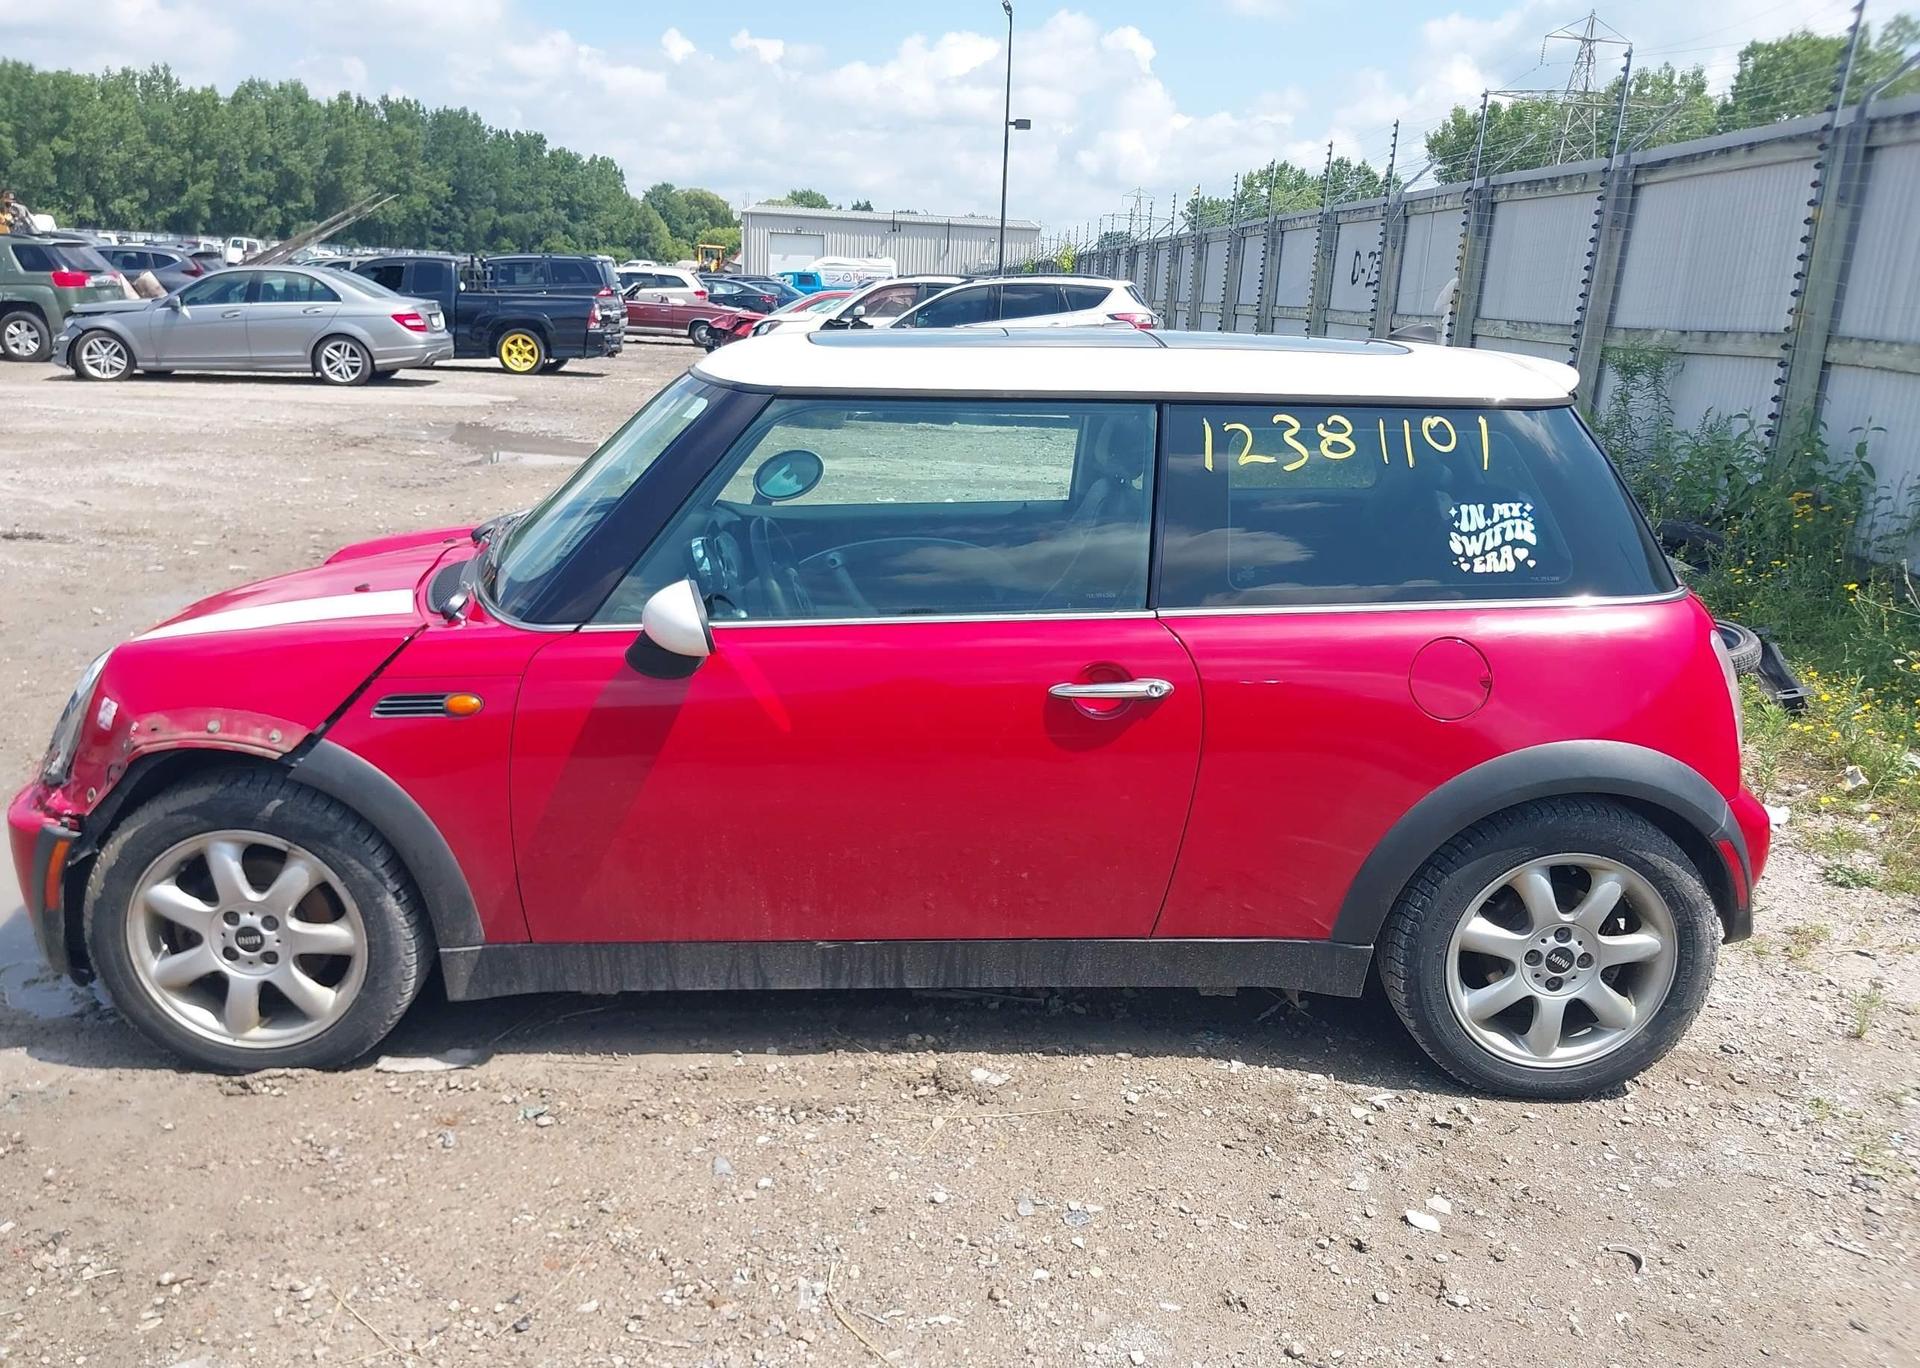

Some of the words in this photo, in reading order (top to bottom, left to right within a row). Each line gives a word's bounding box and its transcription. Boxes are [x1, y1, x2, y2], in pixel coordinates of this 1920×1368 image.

[1203, 414, 1489, 472] 12381101
[1459, 503, 1486, 532] IN
[1492, 502, 1523, 523] MY
[1448, 518, 1537, 557] SWIFTIE
[1473, 545, 1516, 573] ERA
[1548, 952, 1570, 969] MINI
